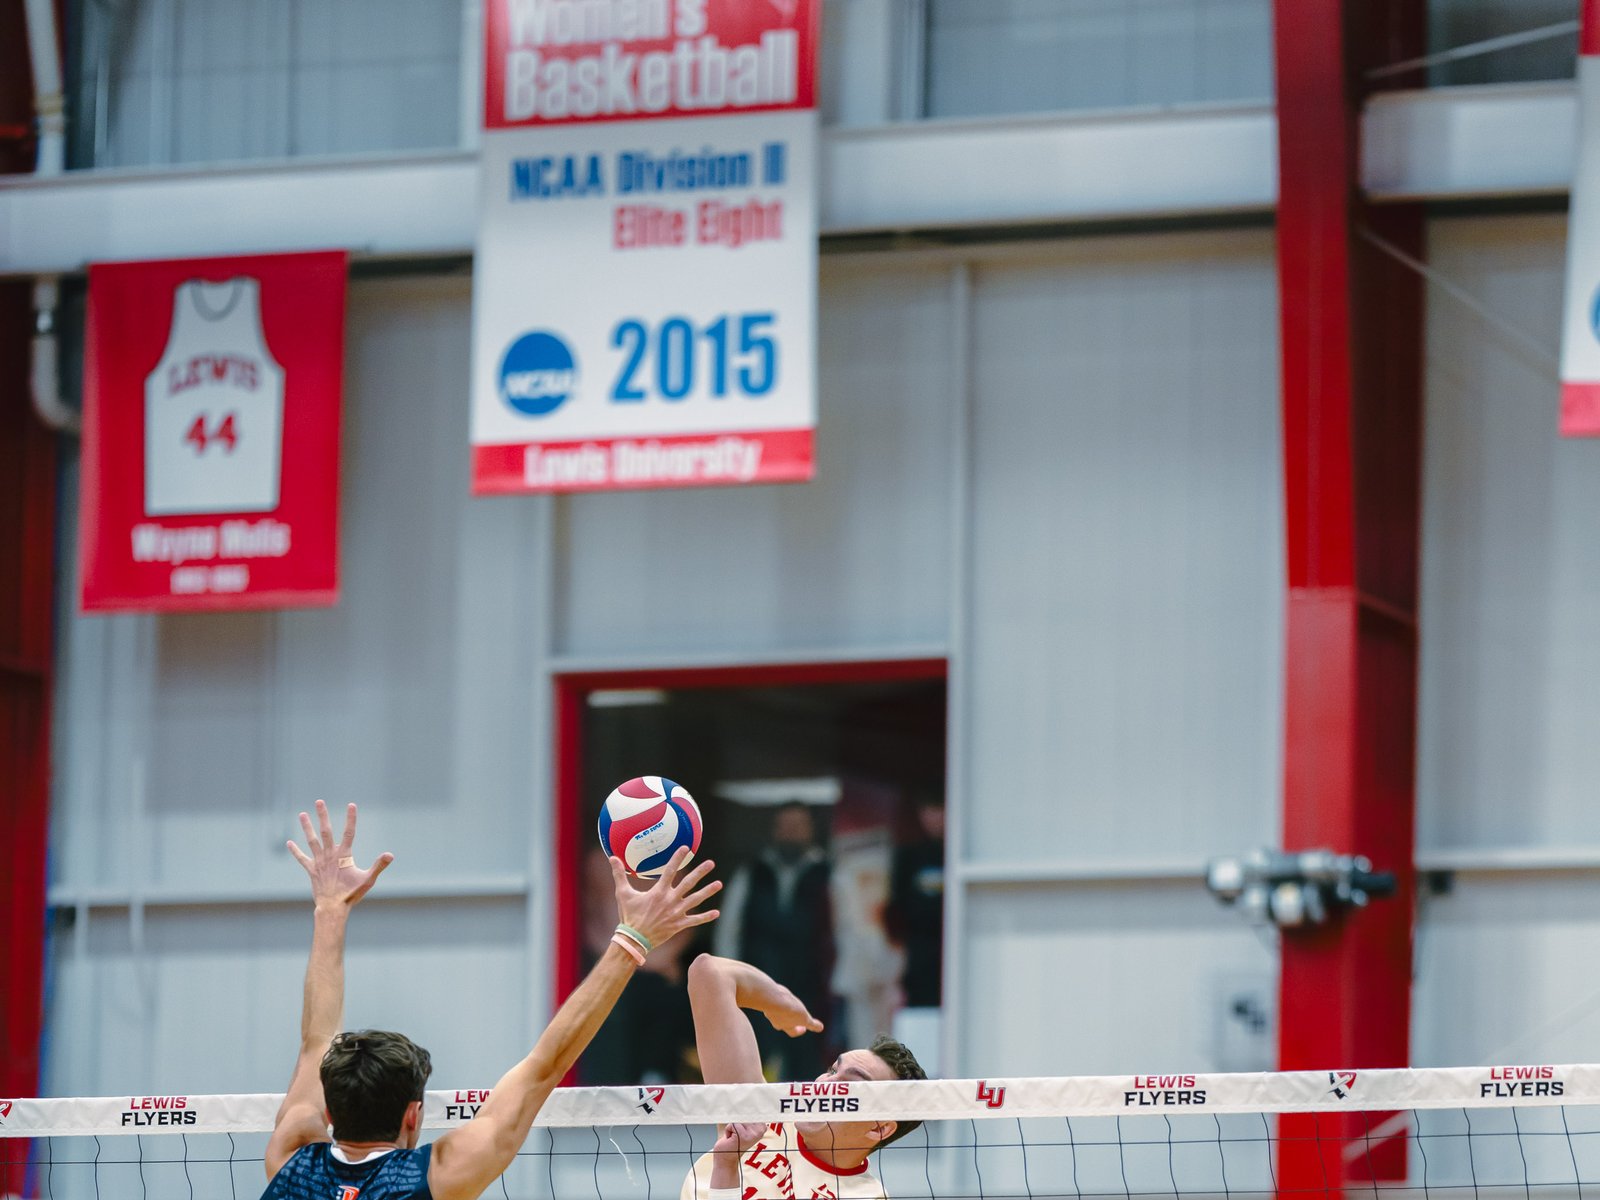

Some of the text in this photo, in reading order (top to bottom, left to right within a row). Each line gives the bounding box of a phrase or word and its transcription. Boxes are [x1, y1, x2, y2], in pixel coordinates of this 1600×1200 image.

[509, 0, 706, 44] Womens
[506, 29, 798, 120] Basketball
[510, 156, 604, 201] NCAA
[615, 148, 752, 195] Division
[614, 199, 783, 249] Elite Eight
[611, 313, 776, 403] 2015
[169, 356, 260, 397] LEWIS
[186, 412, 238, 455] 44
[524, 435, 761, 486] Lewis University
[1134, 1076, 1196, 1089] LEWIS
[1491, 1067, 1553, 1080] LEWIS
[130, 1096, 187, 1110] LEWIS
[789, 1083, 849, 1096] LEWIS
[1124, 1090, 1206, 1106] FLYERS
[1480, 1081, 1564, 1098] FLYERS
[121, 1110, 197, 1126] FLYERS
[780, 1097, 859, 1113] FLYERS
